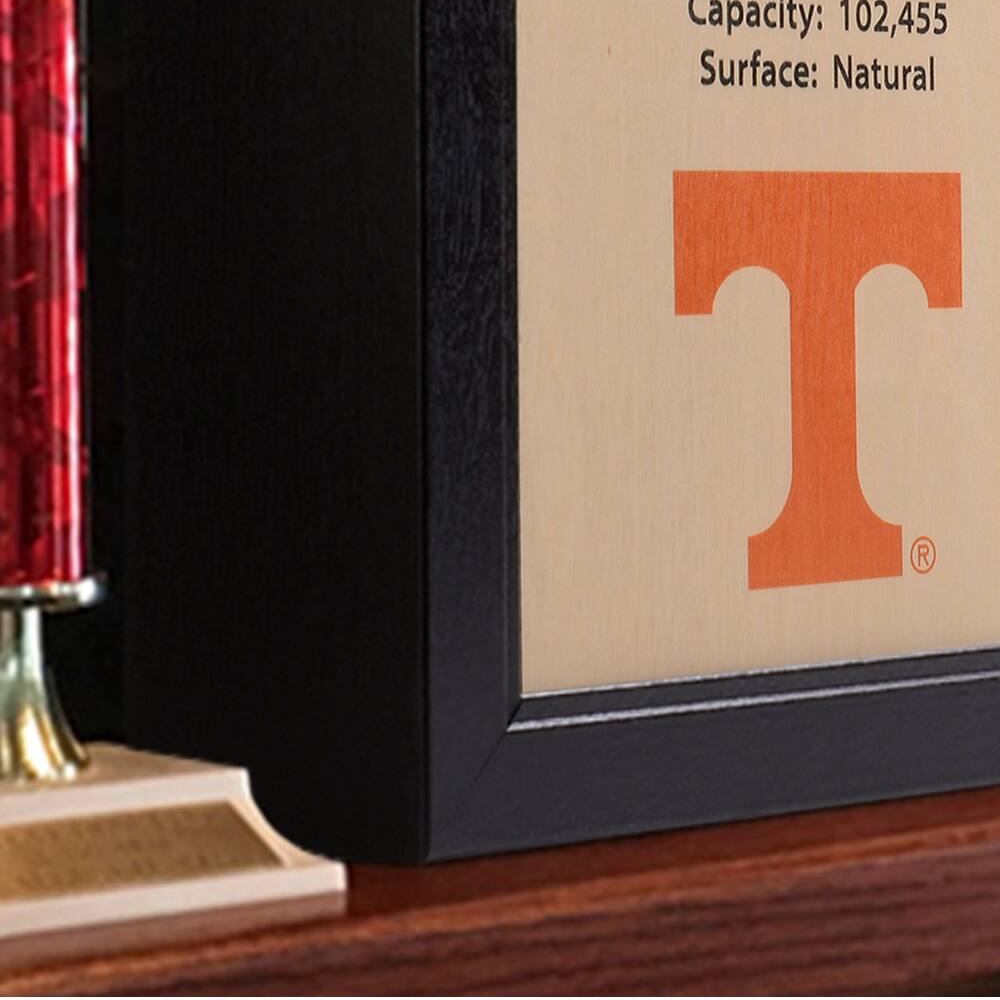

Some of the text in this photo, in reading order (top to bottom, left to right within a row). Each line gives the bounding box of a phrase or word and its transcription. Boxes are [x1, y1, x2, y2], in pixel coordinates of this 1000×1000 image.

[700, 48, 935, 92] Surface: Natural
[673, 170, 963, 590] T
